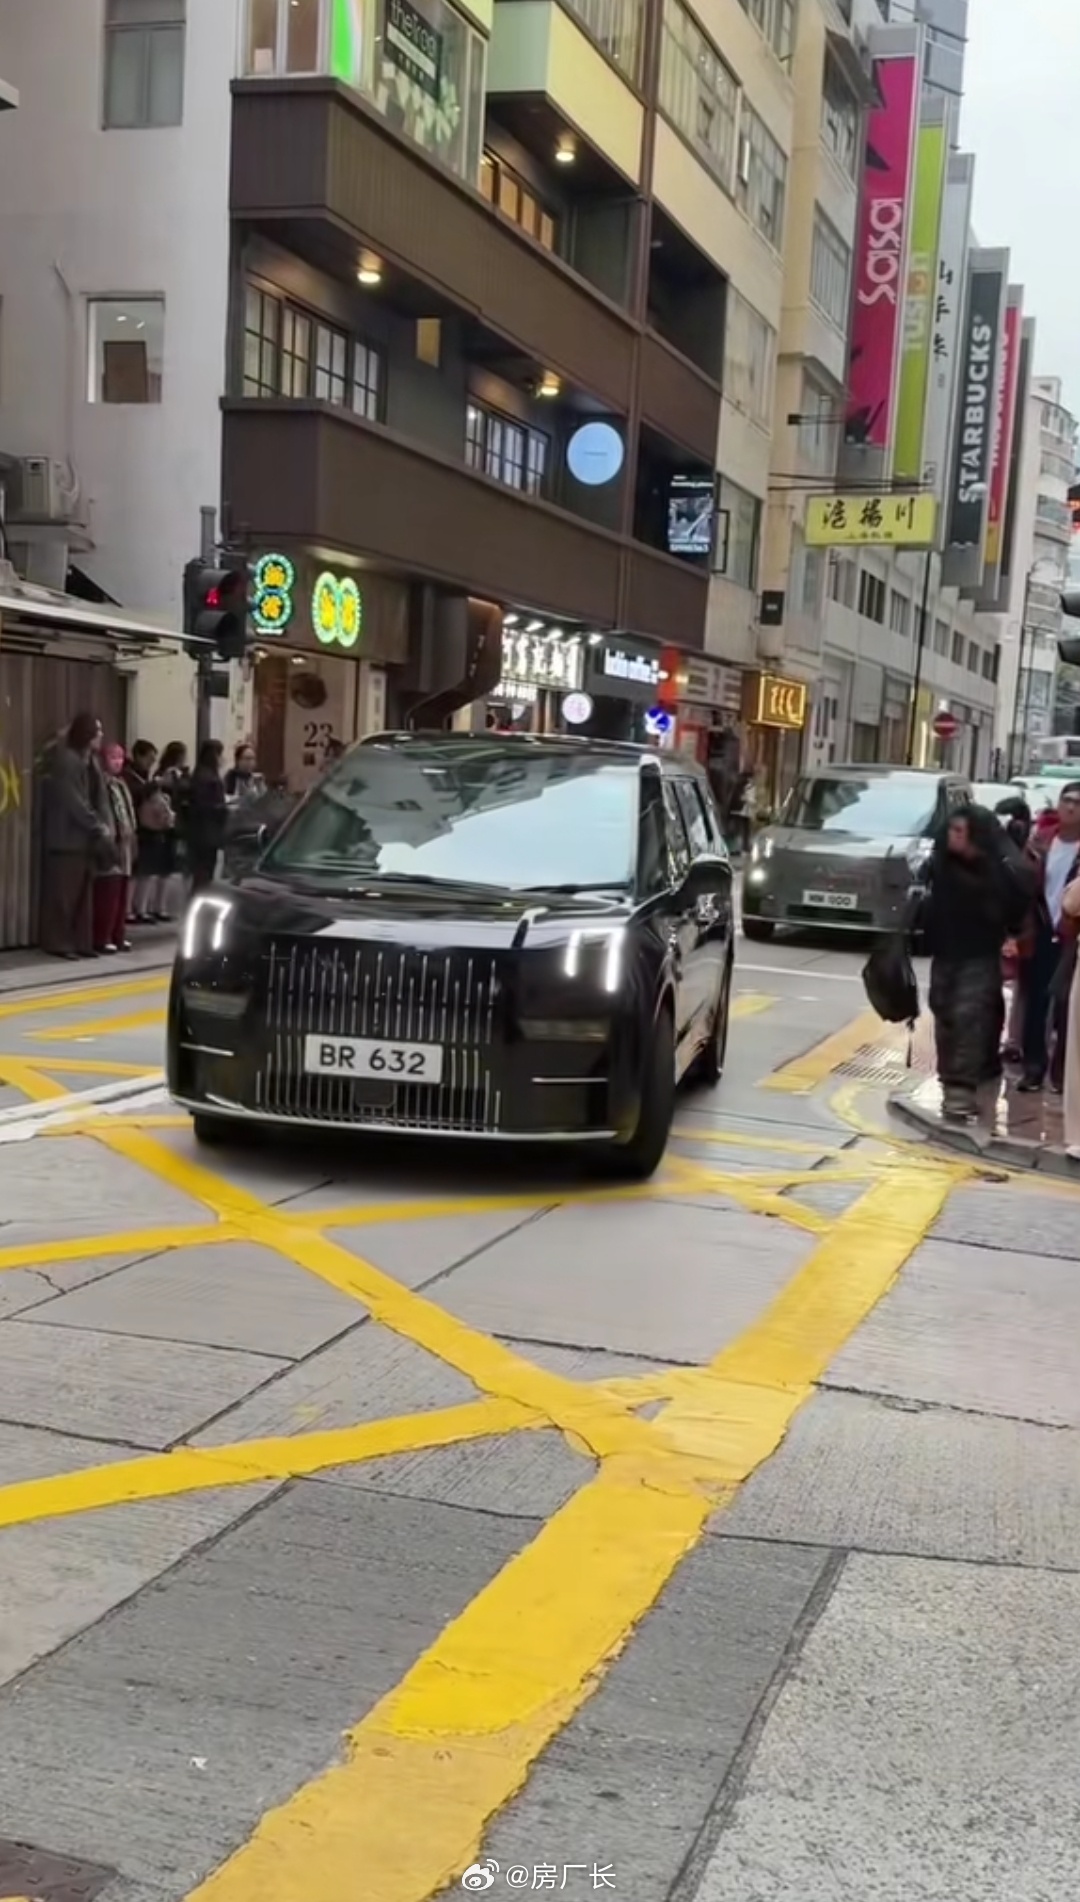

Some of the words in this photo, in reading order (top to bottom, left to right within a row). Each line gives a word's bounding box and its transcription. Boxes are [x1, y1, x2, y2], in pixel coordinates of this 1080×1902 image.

[959, 324, 992, 503] STARBUCKS
[320, 1043, 356, 1069] BR
[369, 1048, 426, 1075] 632
